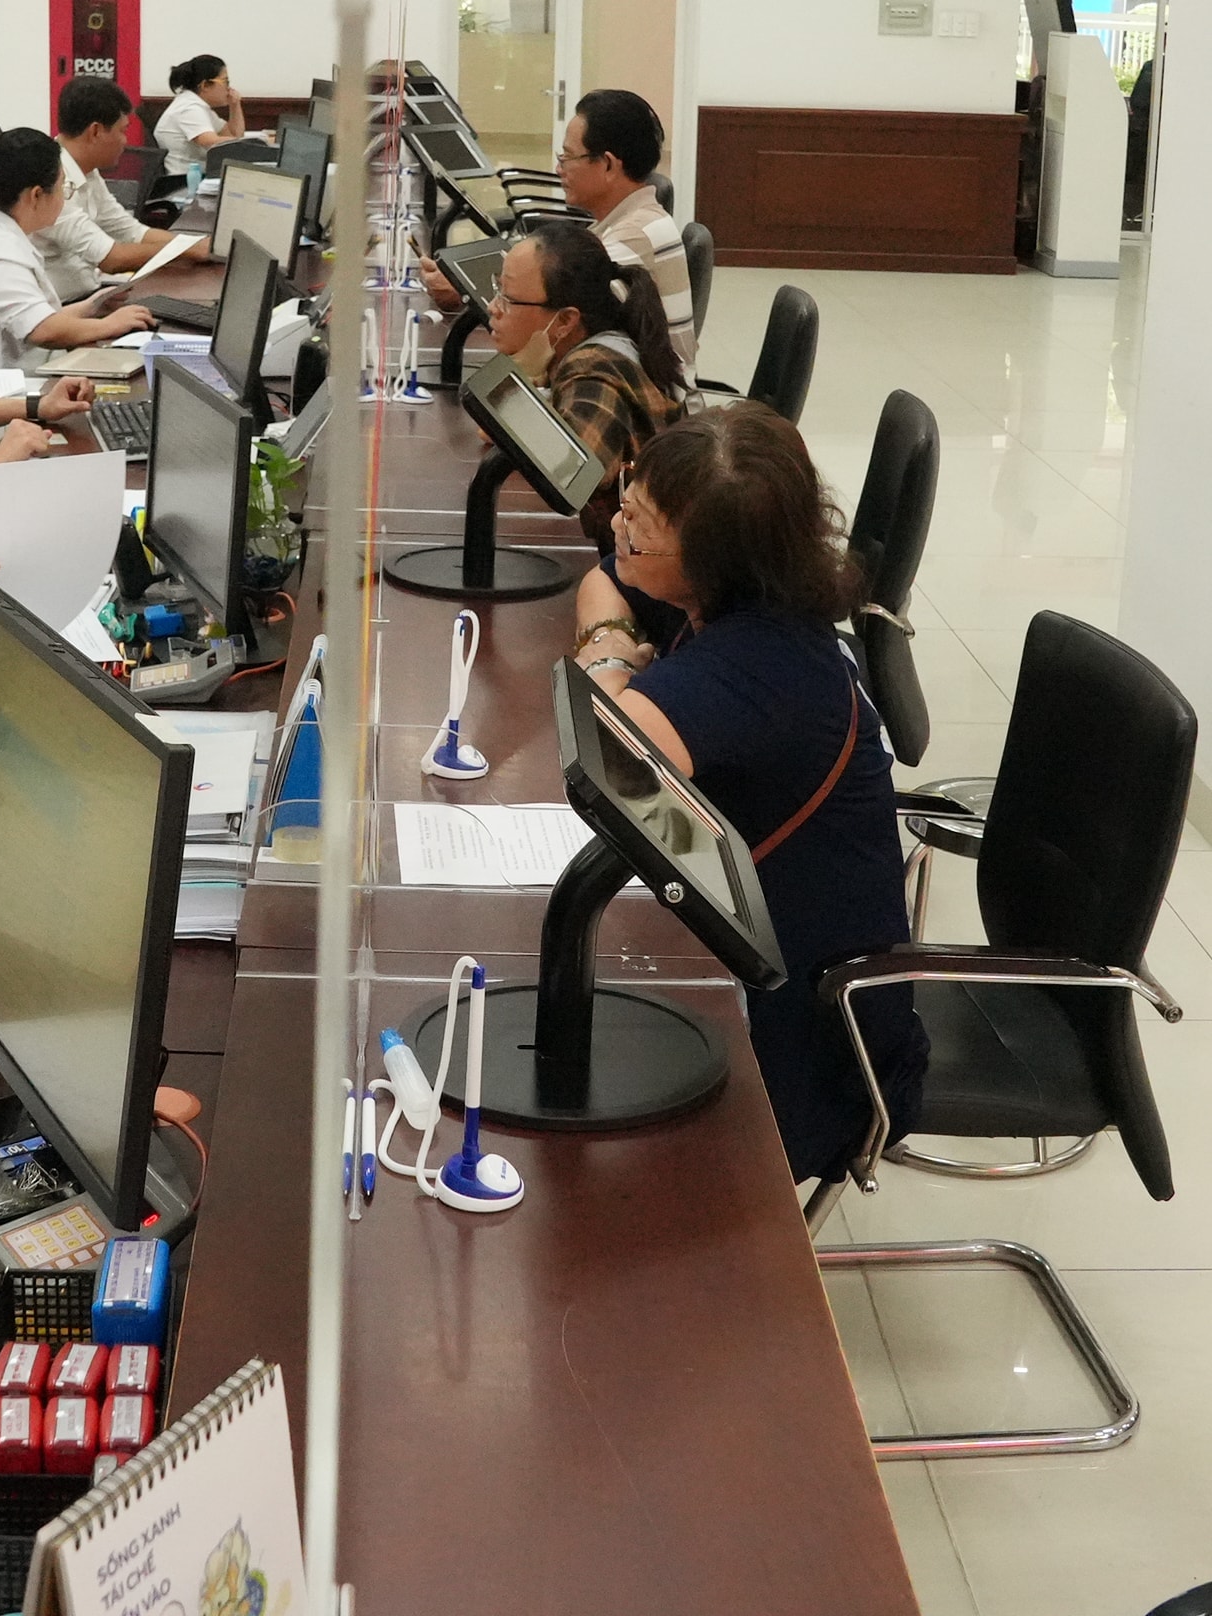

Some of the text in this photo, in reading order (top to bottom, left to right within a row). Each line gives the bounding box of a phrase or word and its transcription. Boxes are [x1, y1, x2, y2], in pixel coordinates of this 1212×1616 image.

[74, 58, 115, 73] PCCC
[96, 1501, 182, 1587] SỐNG XANH
[100, 1548, 157, 1611] TÁI CHẾ
[141, 1576, 172, 1611] VÀO
